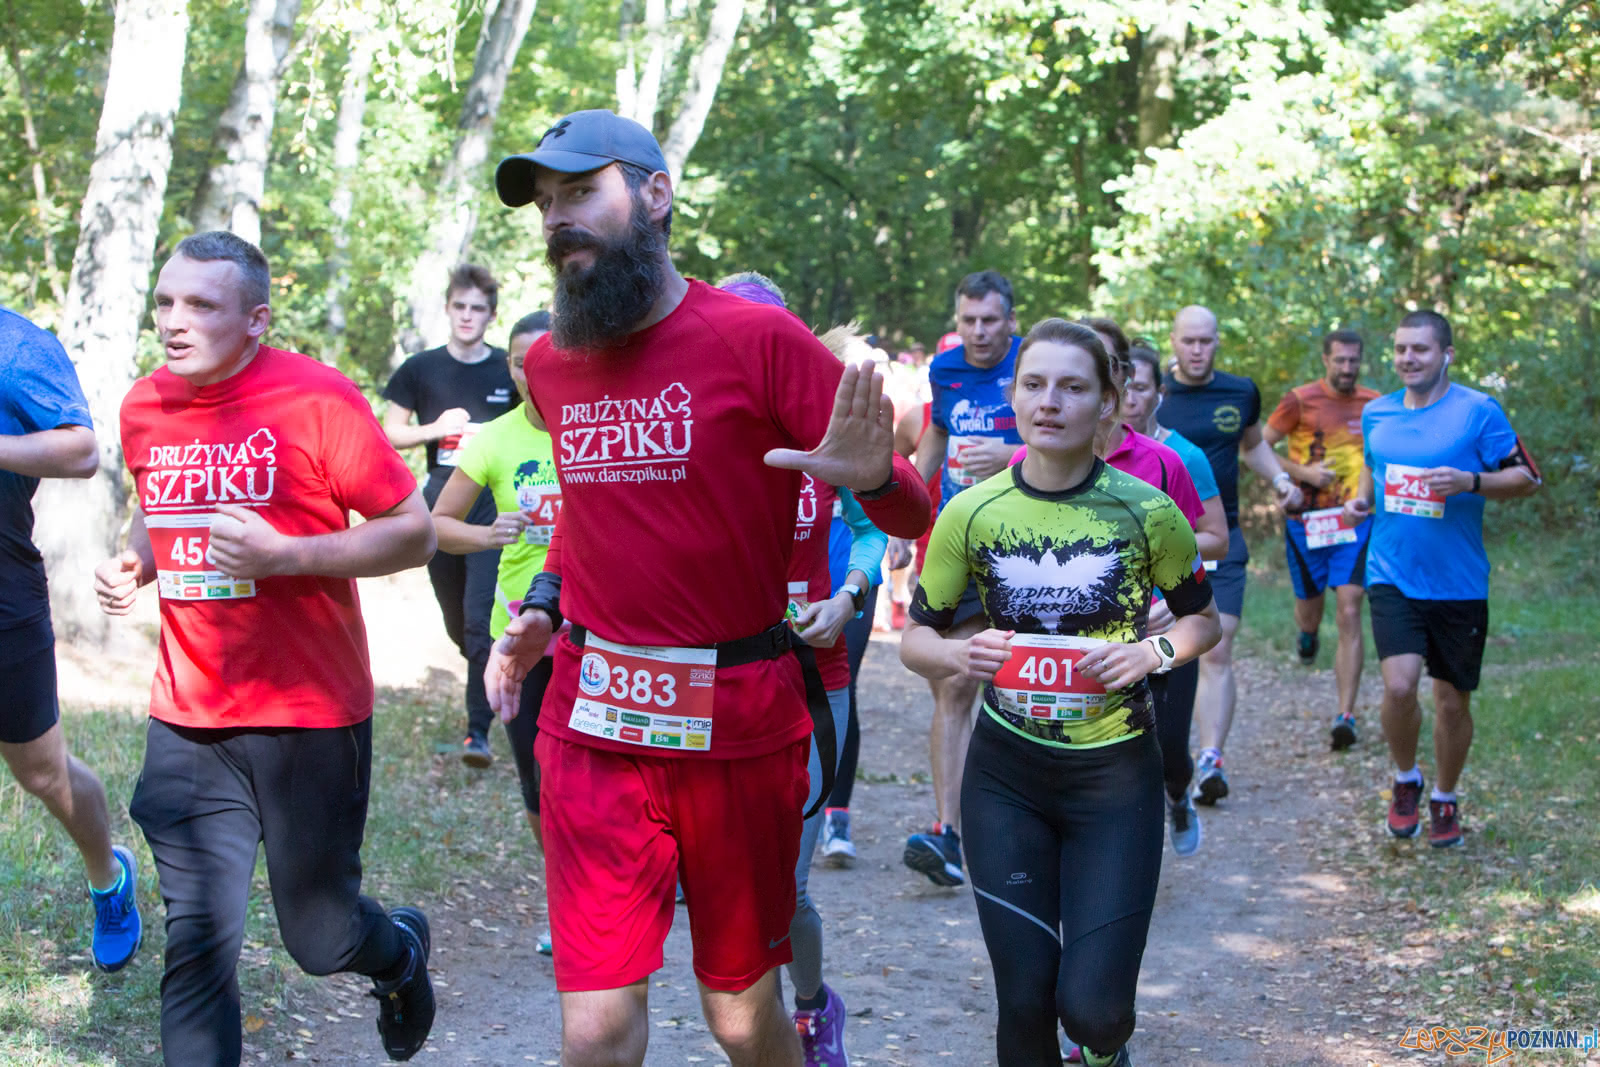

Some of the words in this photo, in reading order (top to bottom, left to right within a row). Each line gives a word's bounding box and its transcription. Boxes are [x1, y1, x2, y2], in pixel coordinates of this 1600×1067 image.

[560, 395, 666, 425] DRUŻYNA
[147, 438, 250, 467] DRUŻYNA
[560, 420, 694, 465] SZPIKU
[145, 466, 277, 506] SZPIKU
[564, 465, 687, 484] www.darszpiku.pl
[1023, 585, 1080, 599] DIRTY
[1001, 601, 1101, 616] SPARROWS
[609, 665, 677, 707] 383
[1018, 656, 1073, 687] 401
